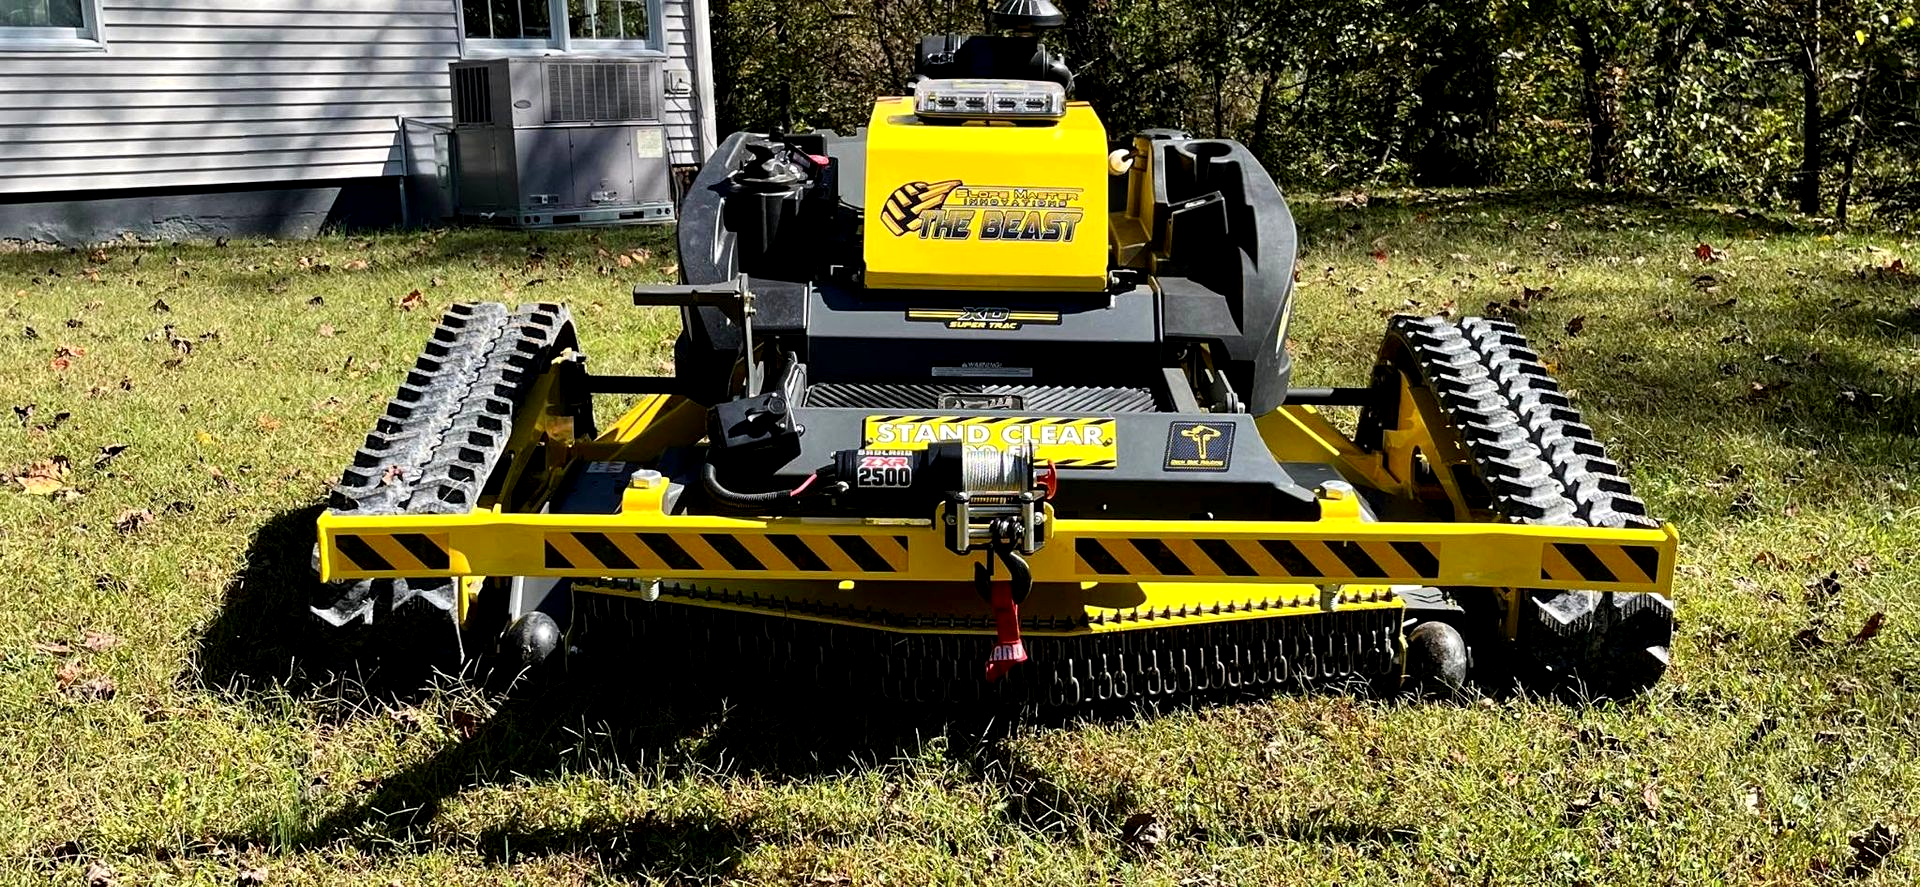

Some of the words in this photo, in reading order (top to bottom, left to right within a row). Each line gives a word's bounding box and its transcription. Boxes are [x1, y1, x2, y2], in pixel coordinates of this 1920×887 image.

[1014, 189, 1078, 200] MASTER
[919, 209, 975, 240] THE
[980, 210, 1083, 242] BEAST
[877, 423, 990, 444] STAND
[1001, 425, 1104, 446] CLEAR
[861, 456, 908, 469] ZXR
[858, 467, 912, 488] 2500
